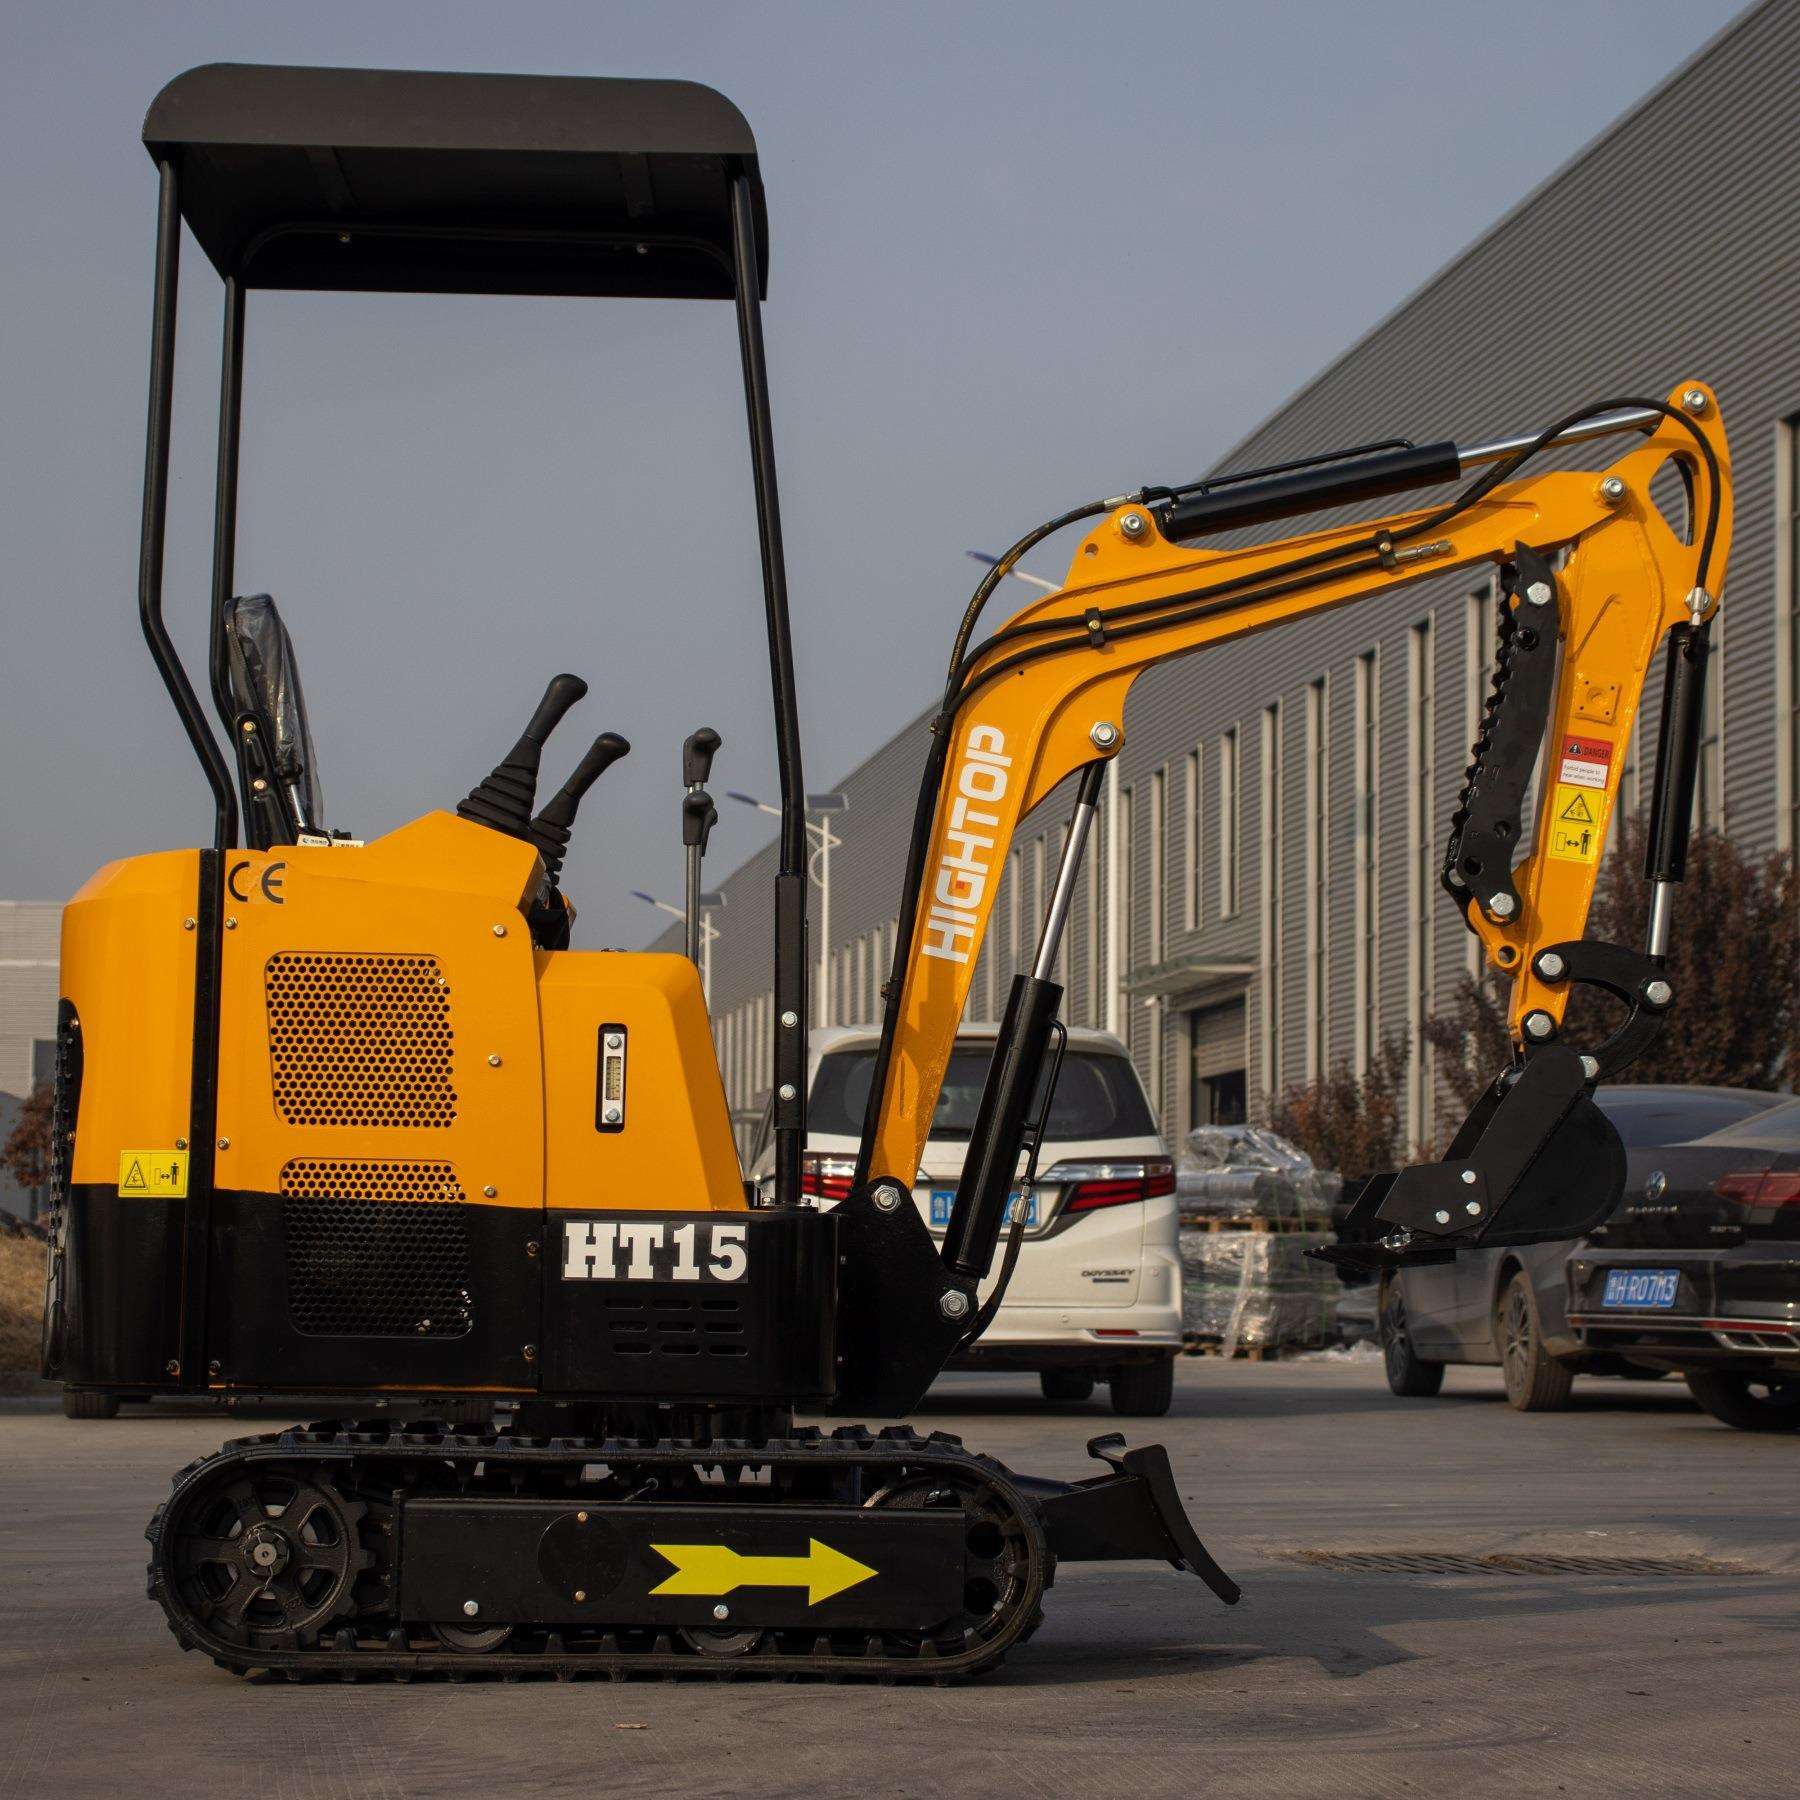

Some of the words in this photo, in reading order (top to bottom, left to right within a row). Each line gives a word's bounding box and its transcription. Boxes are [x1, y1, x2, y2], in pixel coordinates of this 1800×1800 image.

[1584, 747, 1609, 759] DANGER
[922, 725, 1013, 963] HIGHTOP
[228, 861, 285, 904] CE
[564, 1222, 747, 1281] HT15
